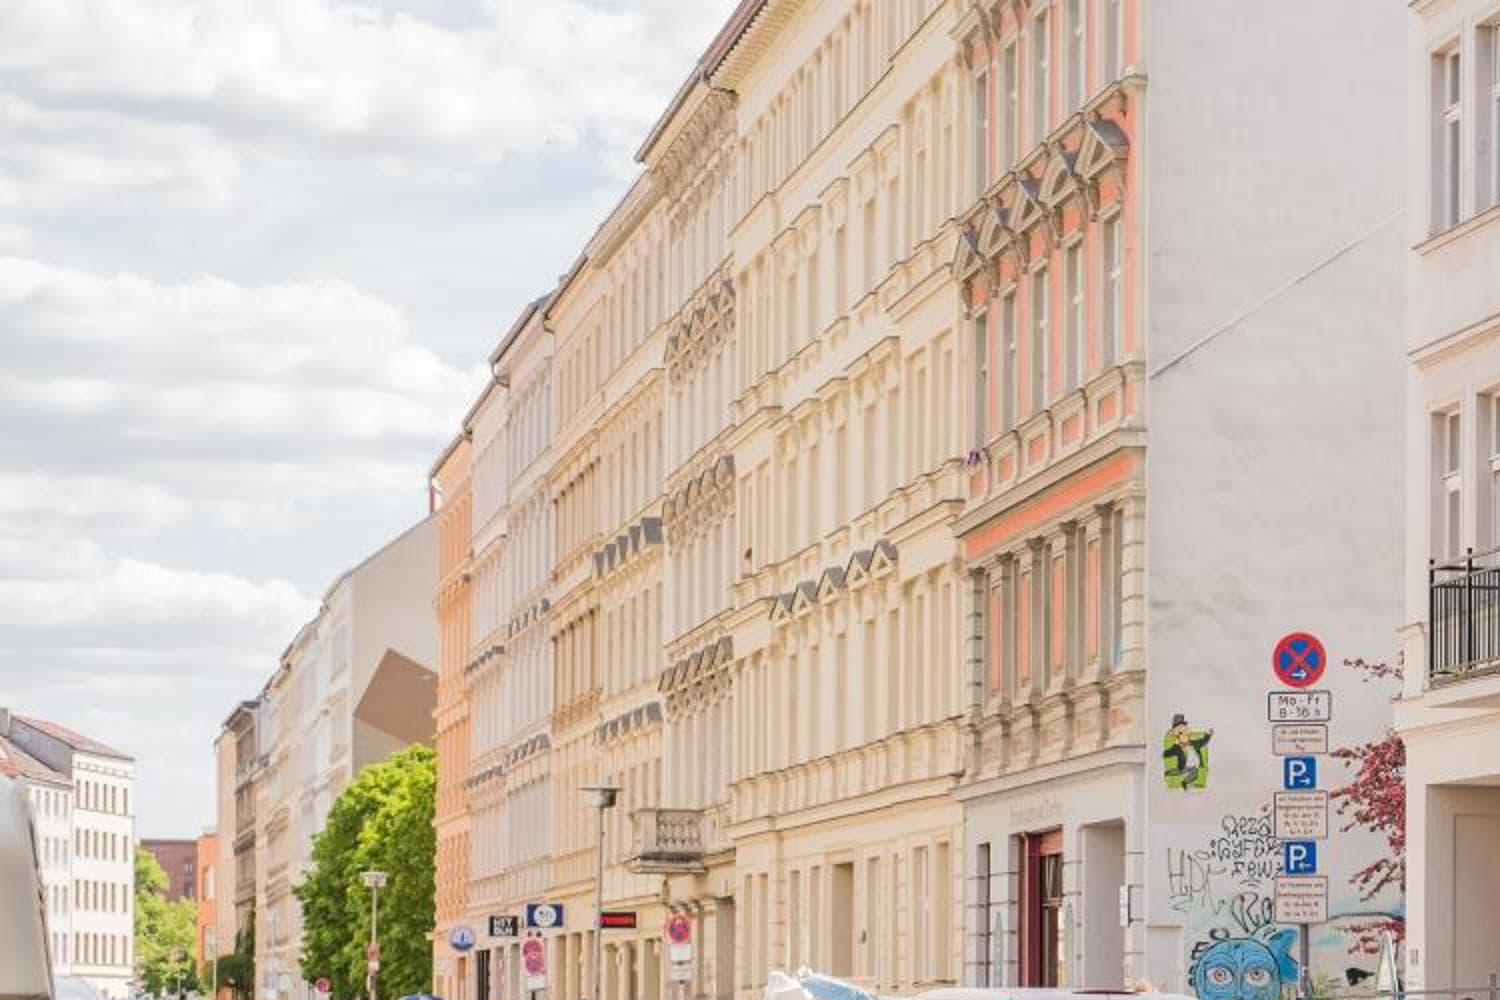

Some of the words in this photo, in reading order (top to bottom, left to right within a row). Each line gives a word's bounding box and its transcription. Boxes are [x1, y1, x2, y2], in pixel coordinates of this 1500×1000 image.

[1278, 695, 1297, 706] Mo
[1289, 760, 1307, 787] P
[1290, 844, 1307, 871] P
